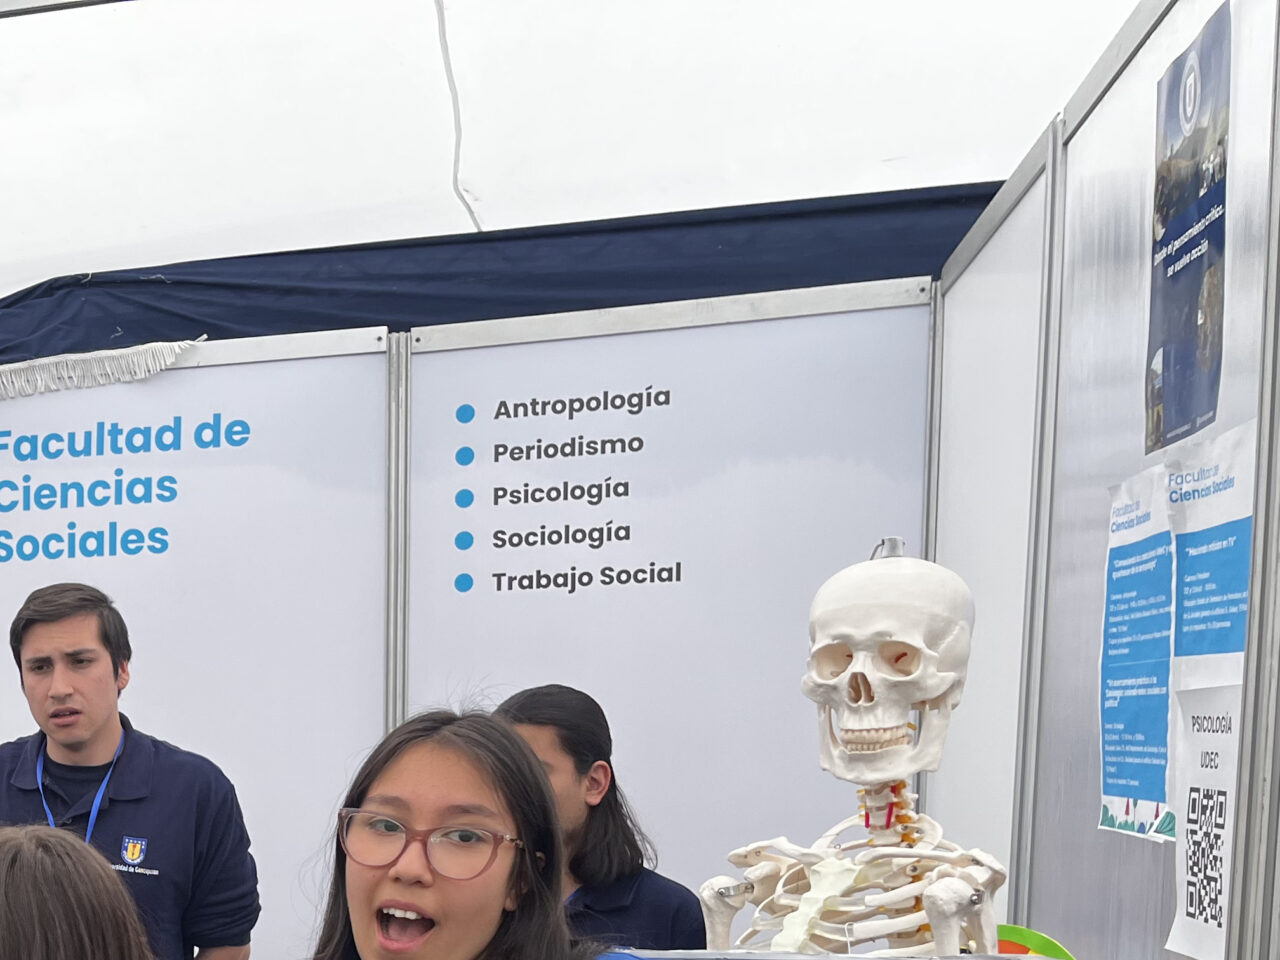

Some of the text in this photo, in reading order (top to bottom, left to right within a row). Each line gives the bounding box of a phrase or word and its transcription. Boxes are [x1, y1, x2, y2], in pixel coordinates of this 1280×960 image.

[493, 385, 671, 421] Antropología
[194, 413, 251, 450] de
[493, 434, 645, 464] Periodismo
[492, 477, 630, 507] Psicología
[492, 520, 631, 550] Sociología
[492, 562, 682, 594] Trabajo Social
[1191, 710, 1233, 735] PSICOLOGÍA
[1200, 751, 1220, 770] UDEC
